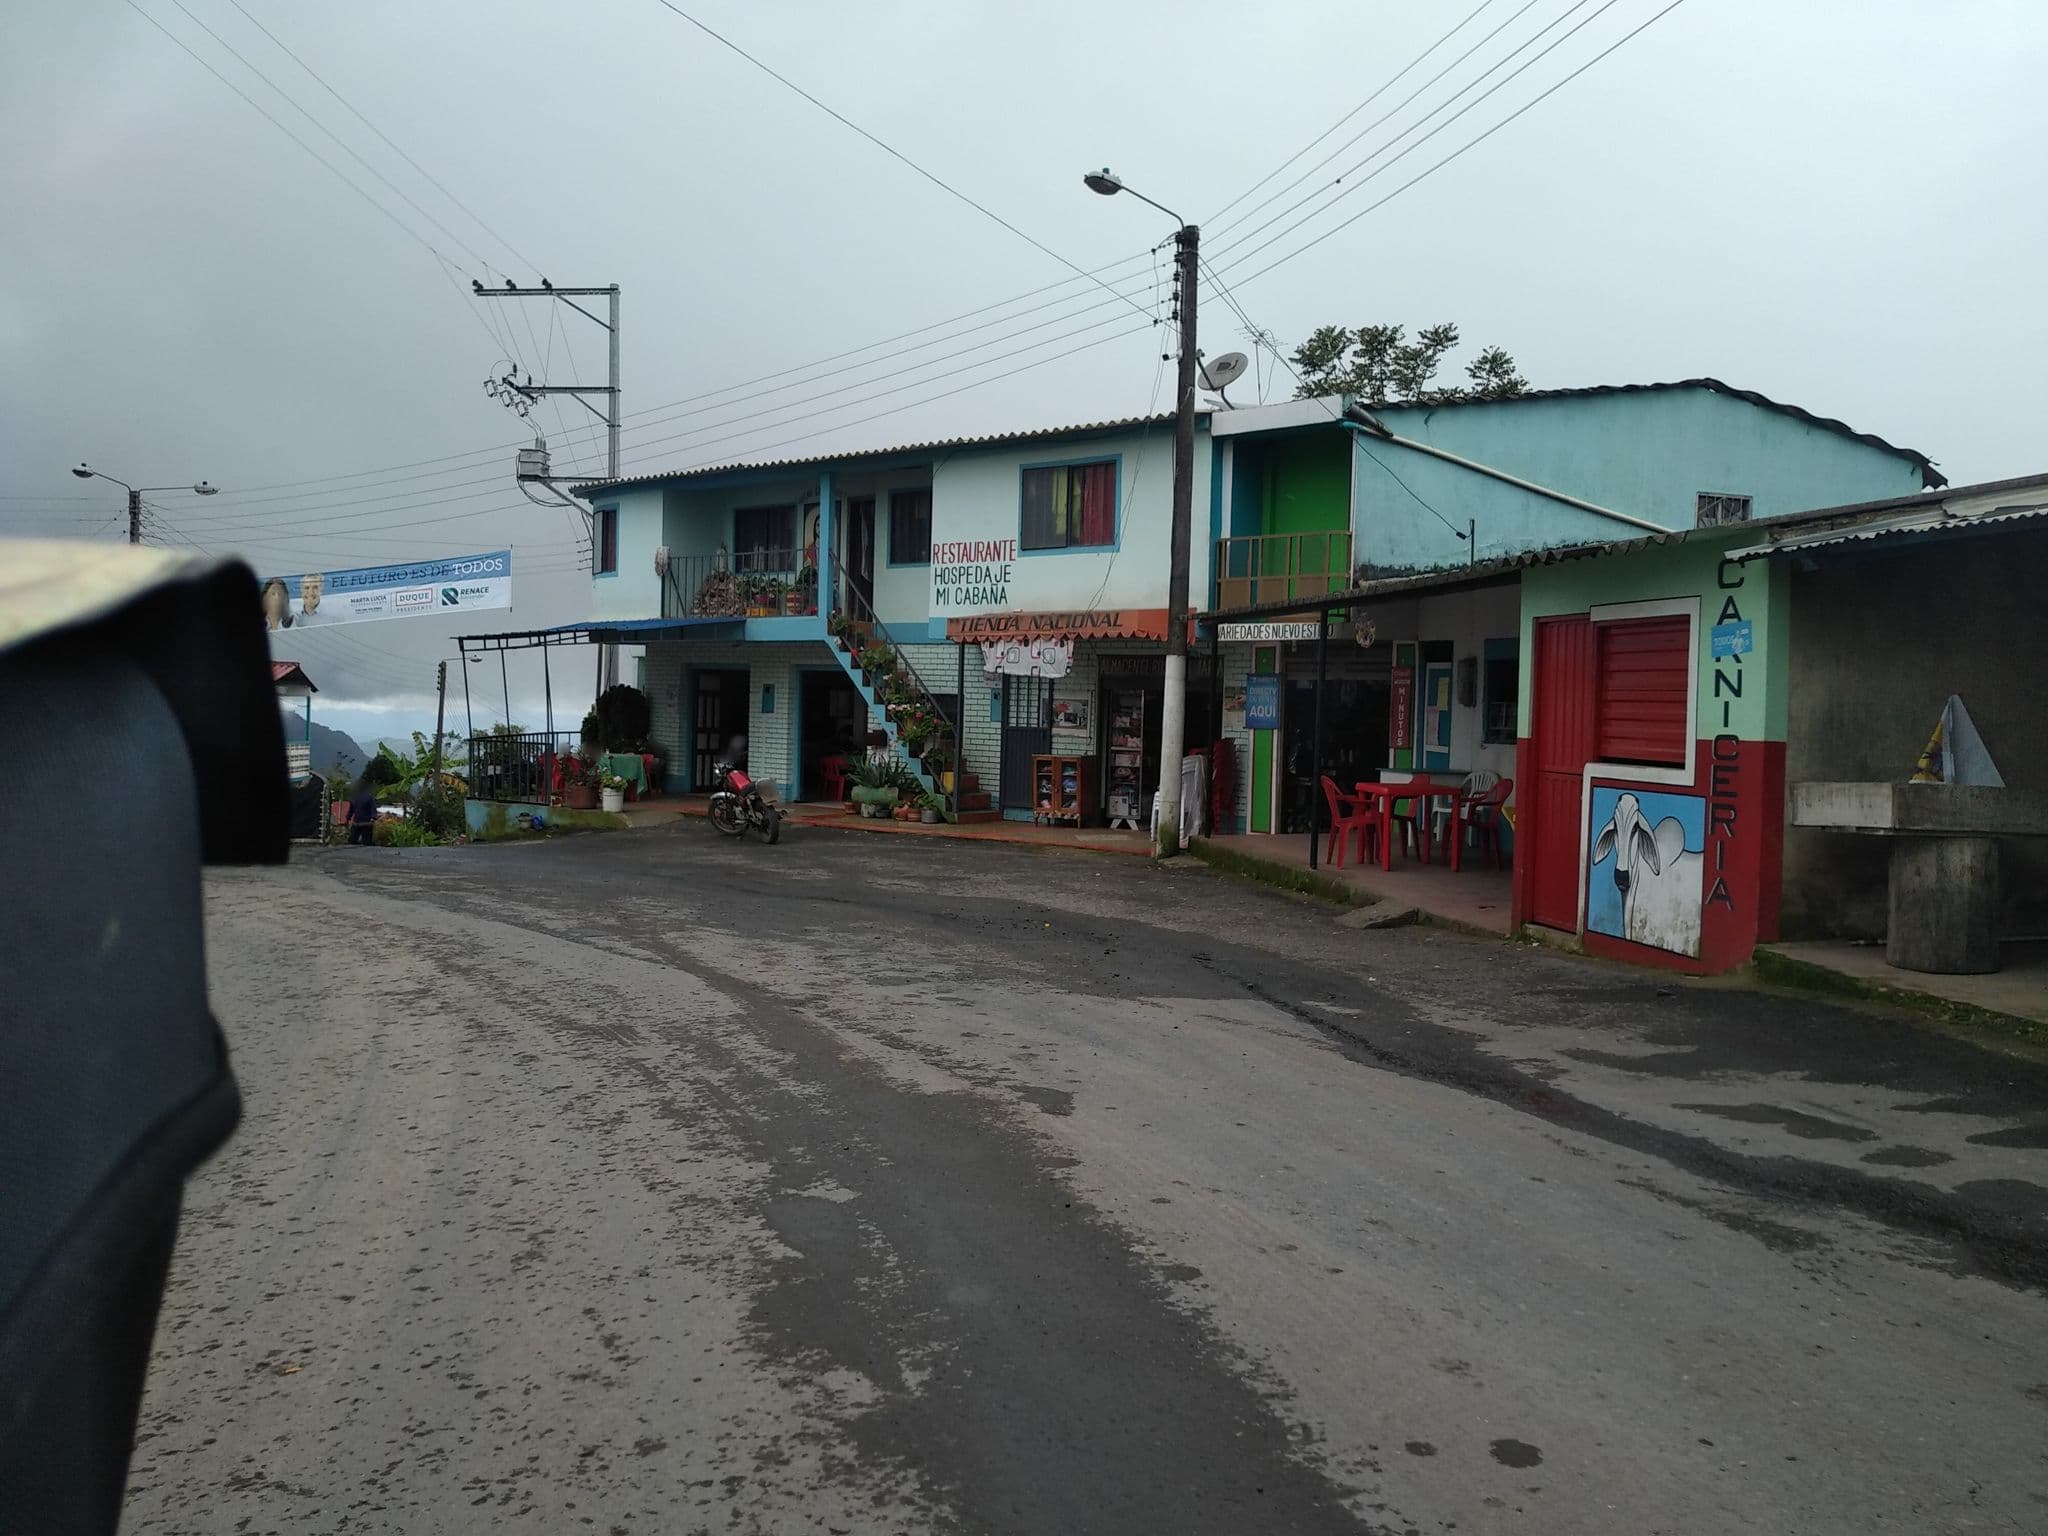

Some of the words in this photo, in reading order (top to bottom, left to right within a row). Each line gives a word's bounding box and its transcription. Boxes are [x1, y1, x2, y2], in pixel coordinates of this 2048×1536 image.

[932, 539, 1016, 564] RESTAURANTE
[331, 576, 347, 588] EL
[350, 569, 408, 586] FUTURO
[452, 558, 503, 575] TODOS
[934, 564, 1011, 585] HOSPEDAJE
[399, 592, 429, 602] DUQUE
[460, 586, 489, 595] RENACE
[936, 587, 949, 605] MI
[955, 583, 1008, 605] CABAÑA
[960, 615, 1019, 632] TIENDA
[1028, 613, 1123, 630] NACIONAL
[1271, 624, 1300, 639] NUEVO
[1396, 687, 1406, 746] MINUTOS
